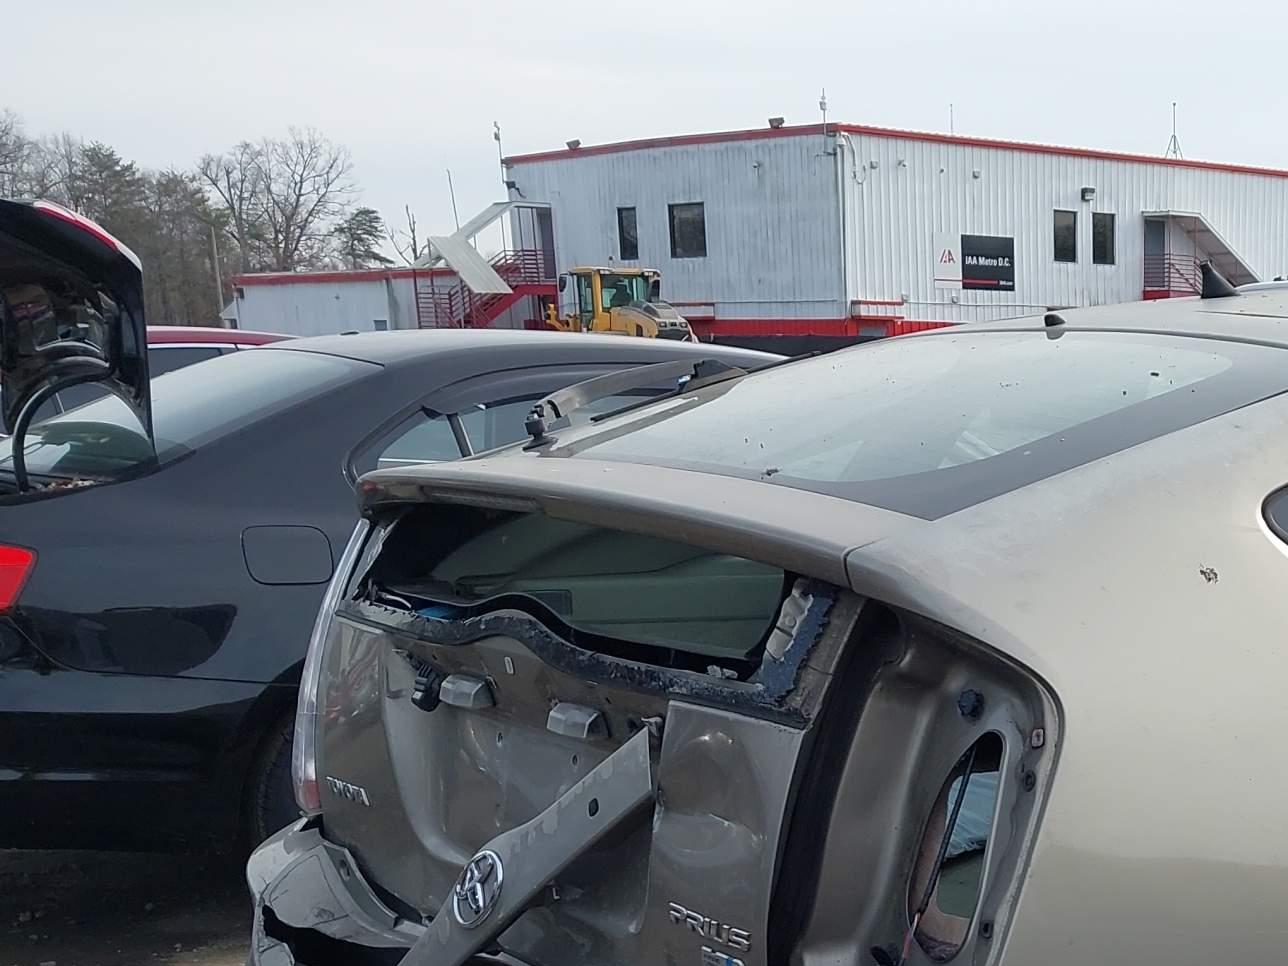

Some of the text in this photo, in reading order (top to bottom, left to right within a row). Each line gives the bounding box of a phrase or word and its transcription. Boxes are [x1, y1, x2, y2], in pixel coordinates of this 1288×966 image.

[965, 255, 978, 265] IAA
[978, 256, 997, 267] Metro
[325, 776, 370, 807] TOYOTA
[668, 902, 752, 952] PRIUS
